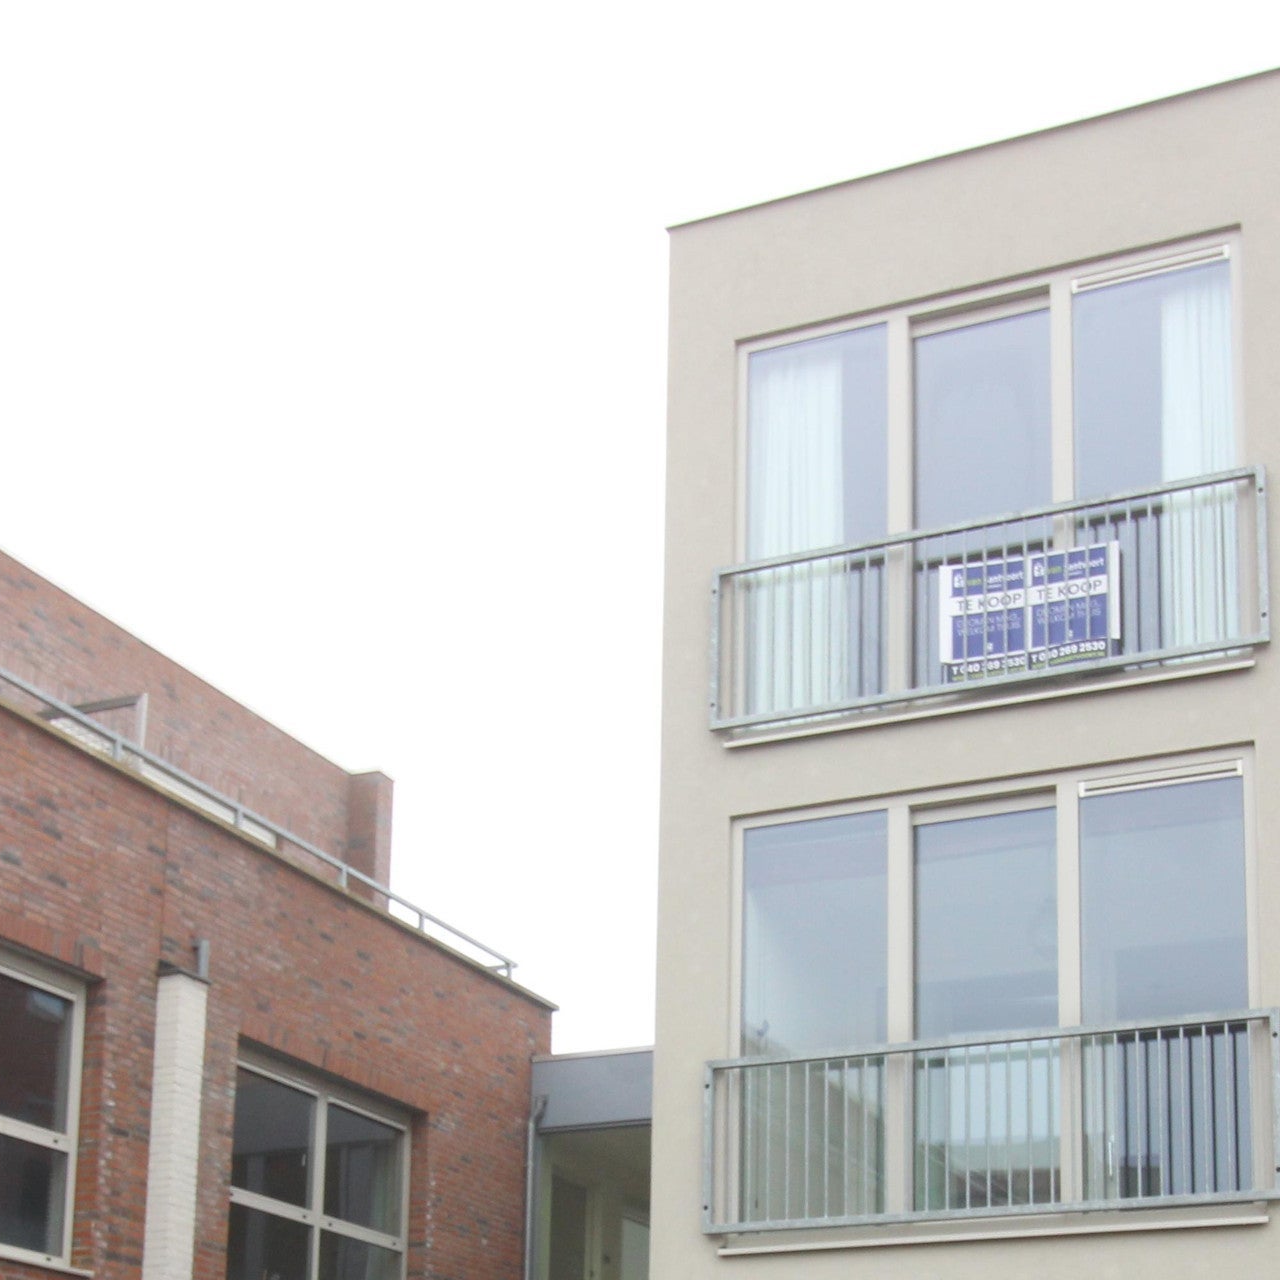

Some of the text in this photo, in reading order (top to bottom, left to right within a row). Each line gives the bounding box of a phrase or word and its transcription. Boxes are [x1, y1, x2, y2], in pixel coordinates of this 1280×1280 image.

[1037, 580, 1102, 601] TE KOOP
[958, 593, 1022, 612] TE KOOP
[1060, 644, 1079, 657] 269
[1080, 641, 1106, 653] 2530
